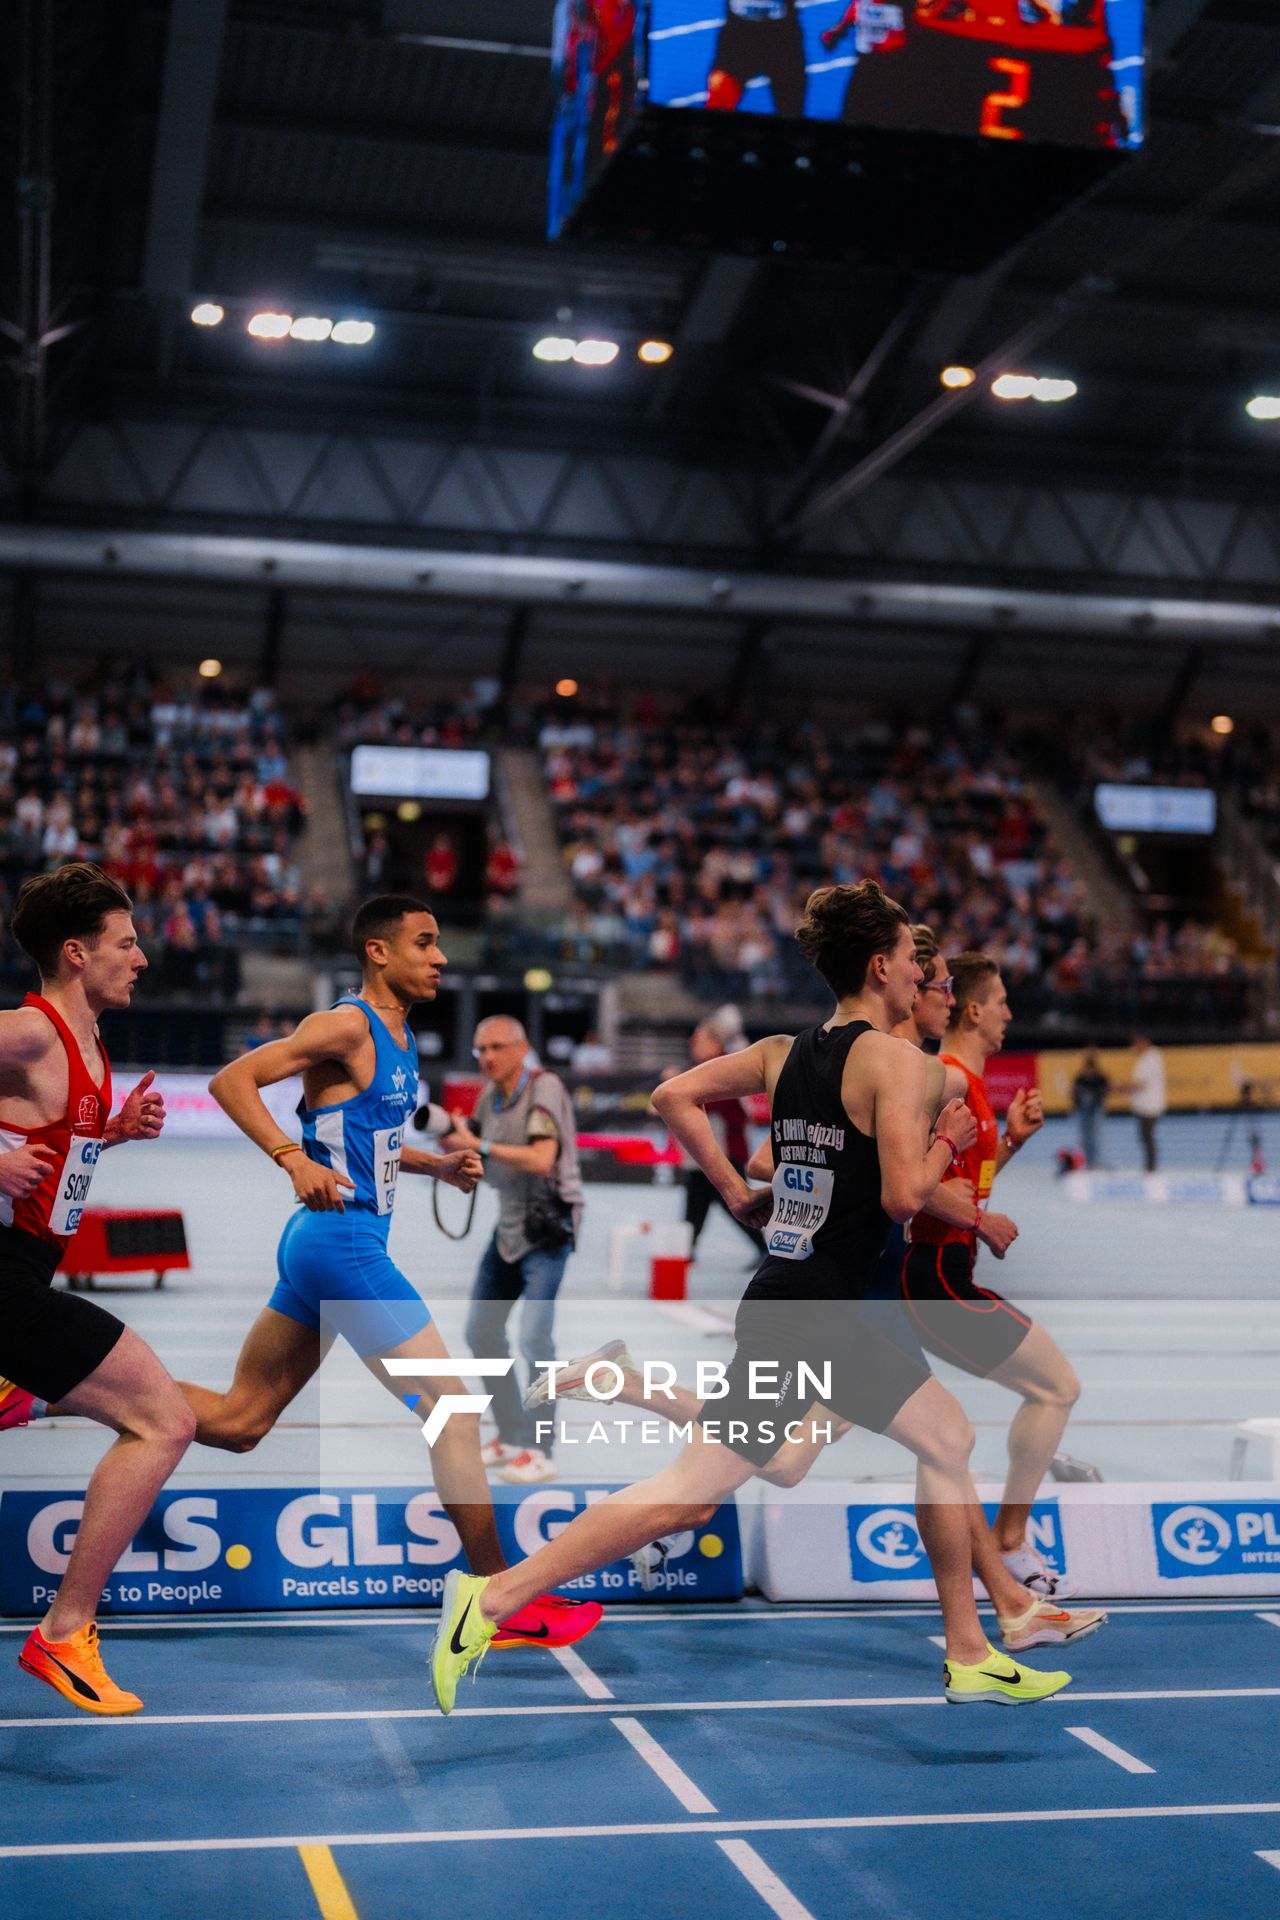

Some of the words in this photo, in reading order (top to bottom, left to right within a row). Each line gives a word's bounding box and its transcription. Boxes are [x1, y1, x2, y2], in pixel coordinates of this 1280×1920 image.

[980, 57, 1031, 140] 2
[807, 1122, 845, 1151] eipzig
[775, 1197, 824, 1230] R.BEIMLER
[282, 1576, 360, 1597] Parcels
[364, 1577, 388, 1594] to
[392, 1575, 445, 1598] Peop
[600, 1571, 625, 1588] to
[628, 1568, 698, 1591] Pople
[118, 1583, 142, 1601] to
[148, 1581, 222, 1605] People
